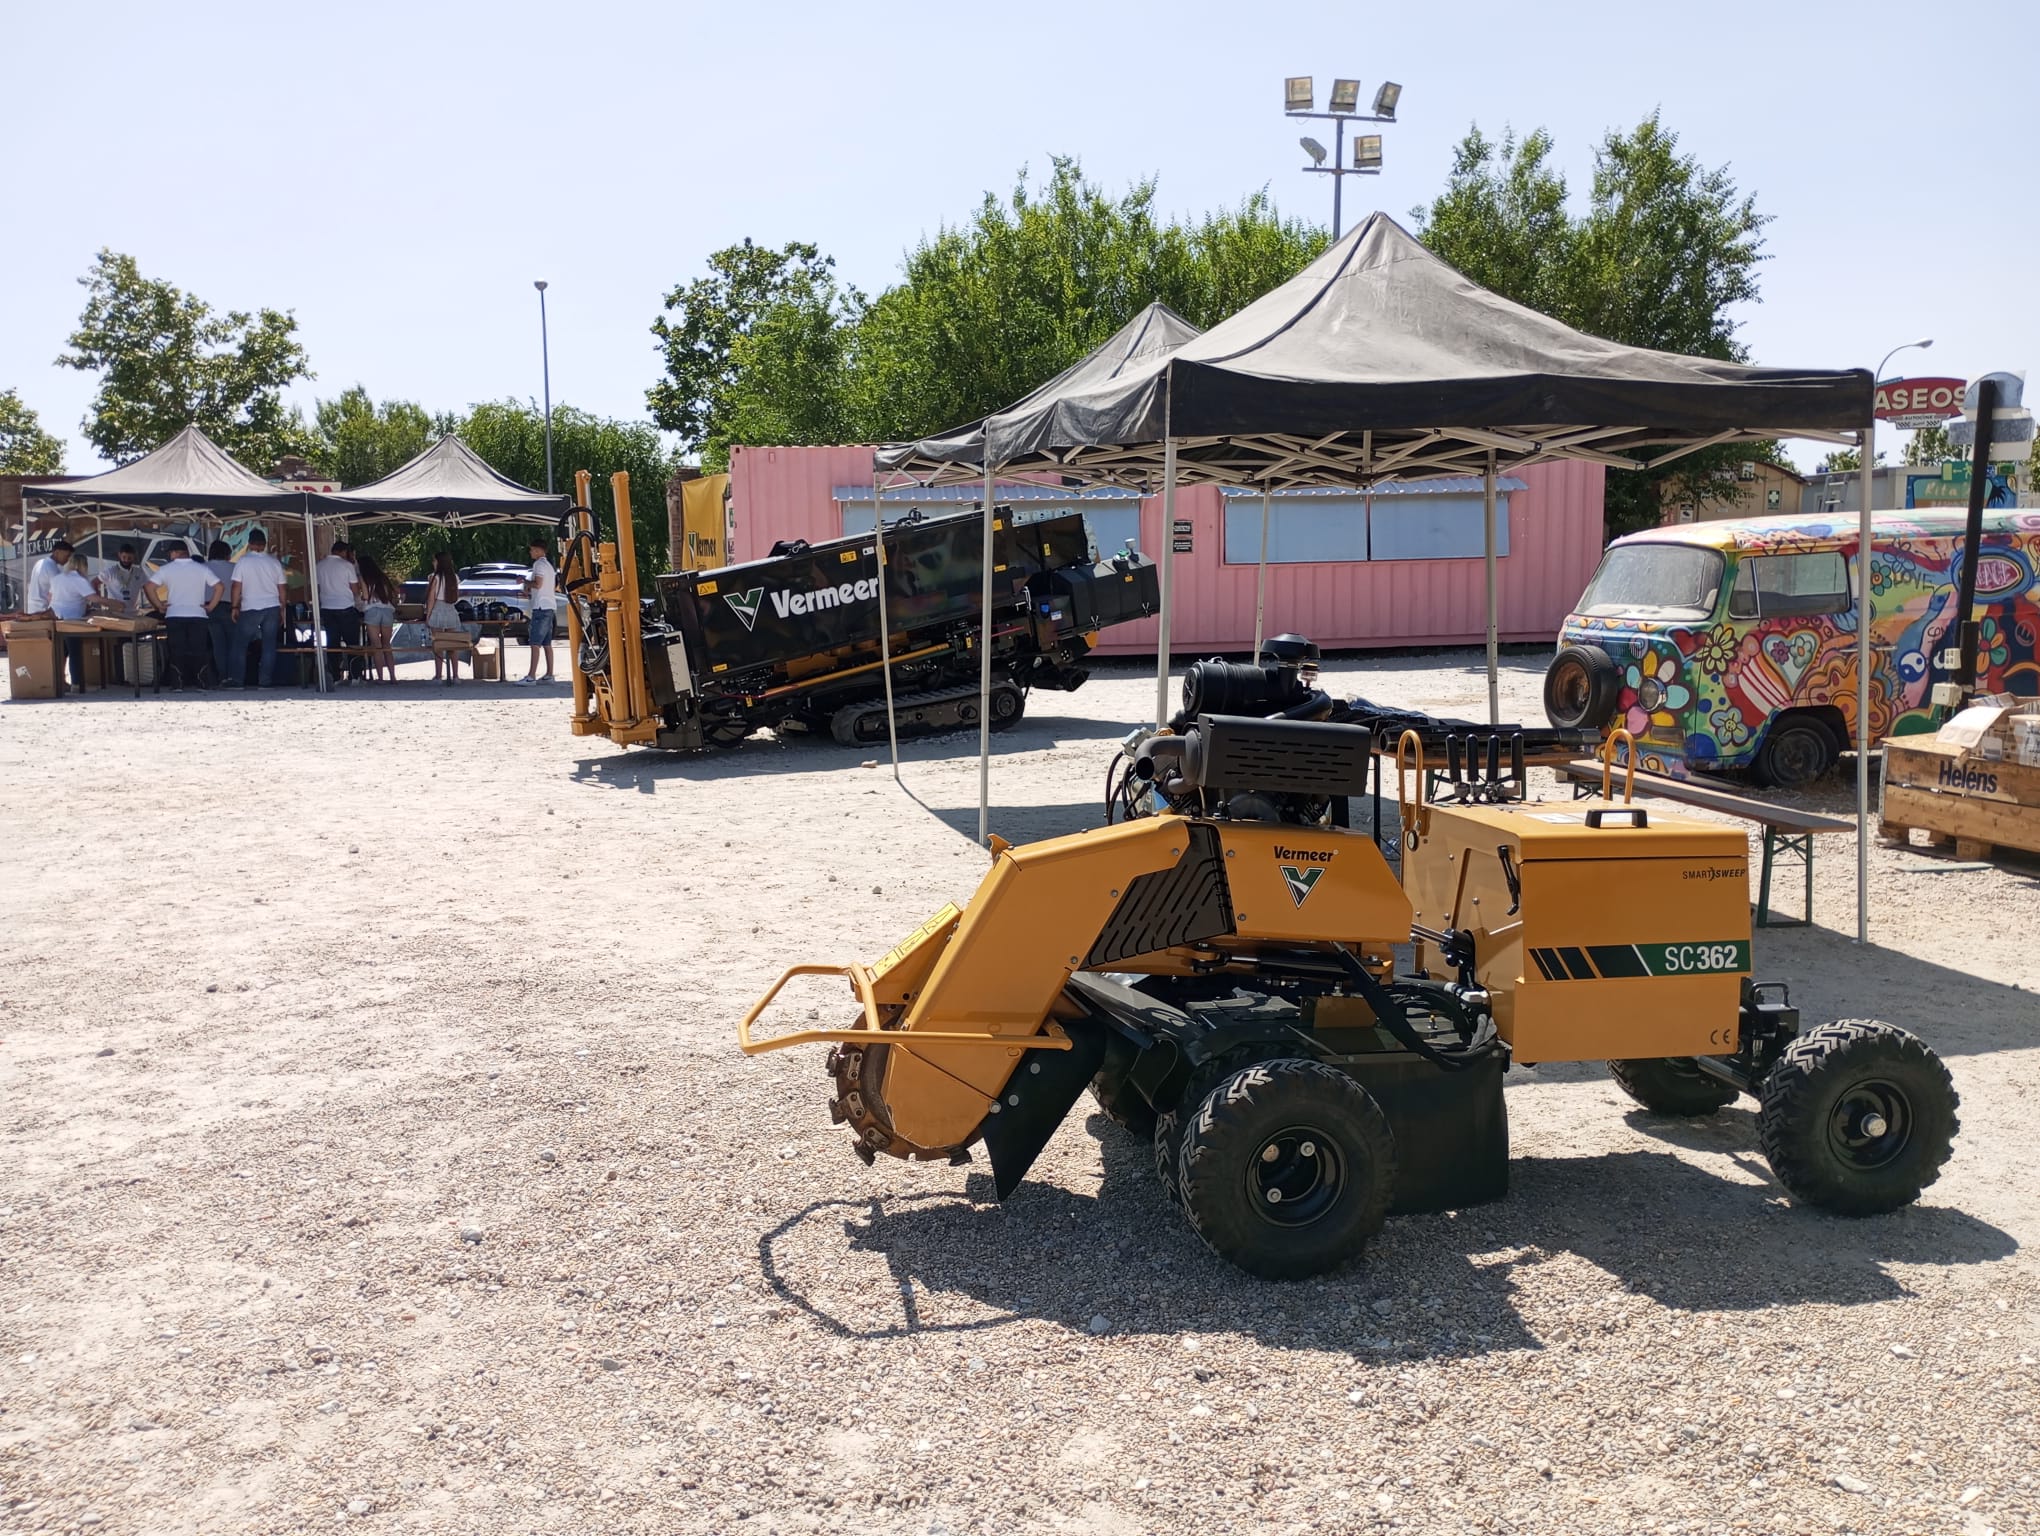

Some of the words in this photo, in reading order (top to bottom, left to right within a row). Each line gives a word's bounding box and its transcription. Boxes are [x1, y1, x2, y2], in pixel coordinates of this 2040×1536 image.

[1875, 385, 1966, 411] ASEOS
[1893, 570, 1935, 593] LOVE
[770, 577, 879, 619] Vermeer
[1938, 759, 1998, 793] Heléns
[1273, 845, 1334, 862] Vermeer
[1664, 945, 1738, 971] SC362
